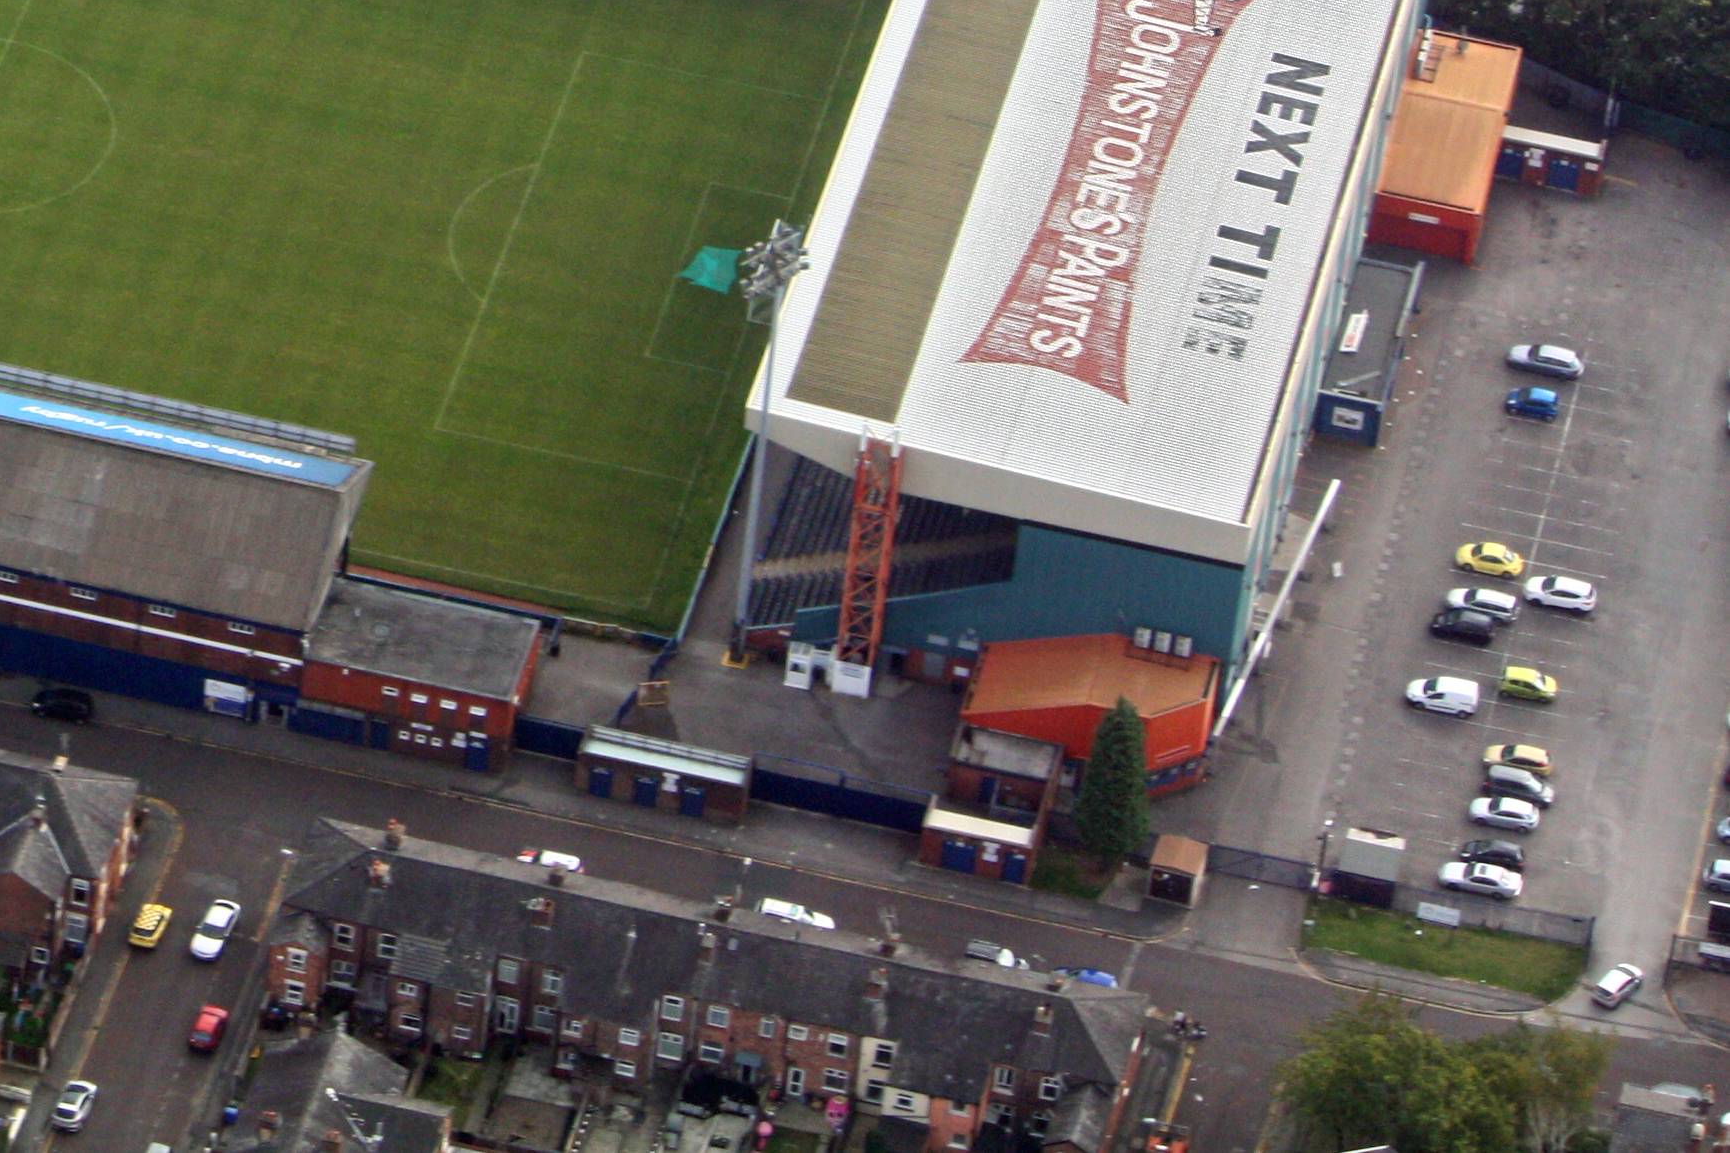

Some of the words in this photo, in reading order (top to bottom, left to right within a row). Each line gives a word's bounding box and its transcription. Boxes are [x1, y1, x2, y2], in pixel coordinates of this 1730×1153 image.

[1234, 52, 1331, 206] NEXT
[1029, 232, 1130, 359] PAINTS
[1181, 223, 1282, 361] TIME
[20, 405, 303, 470] mbna.co.uk/rugby
